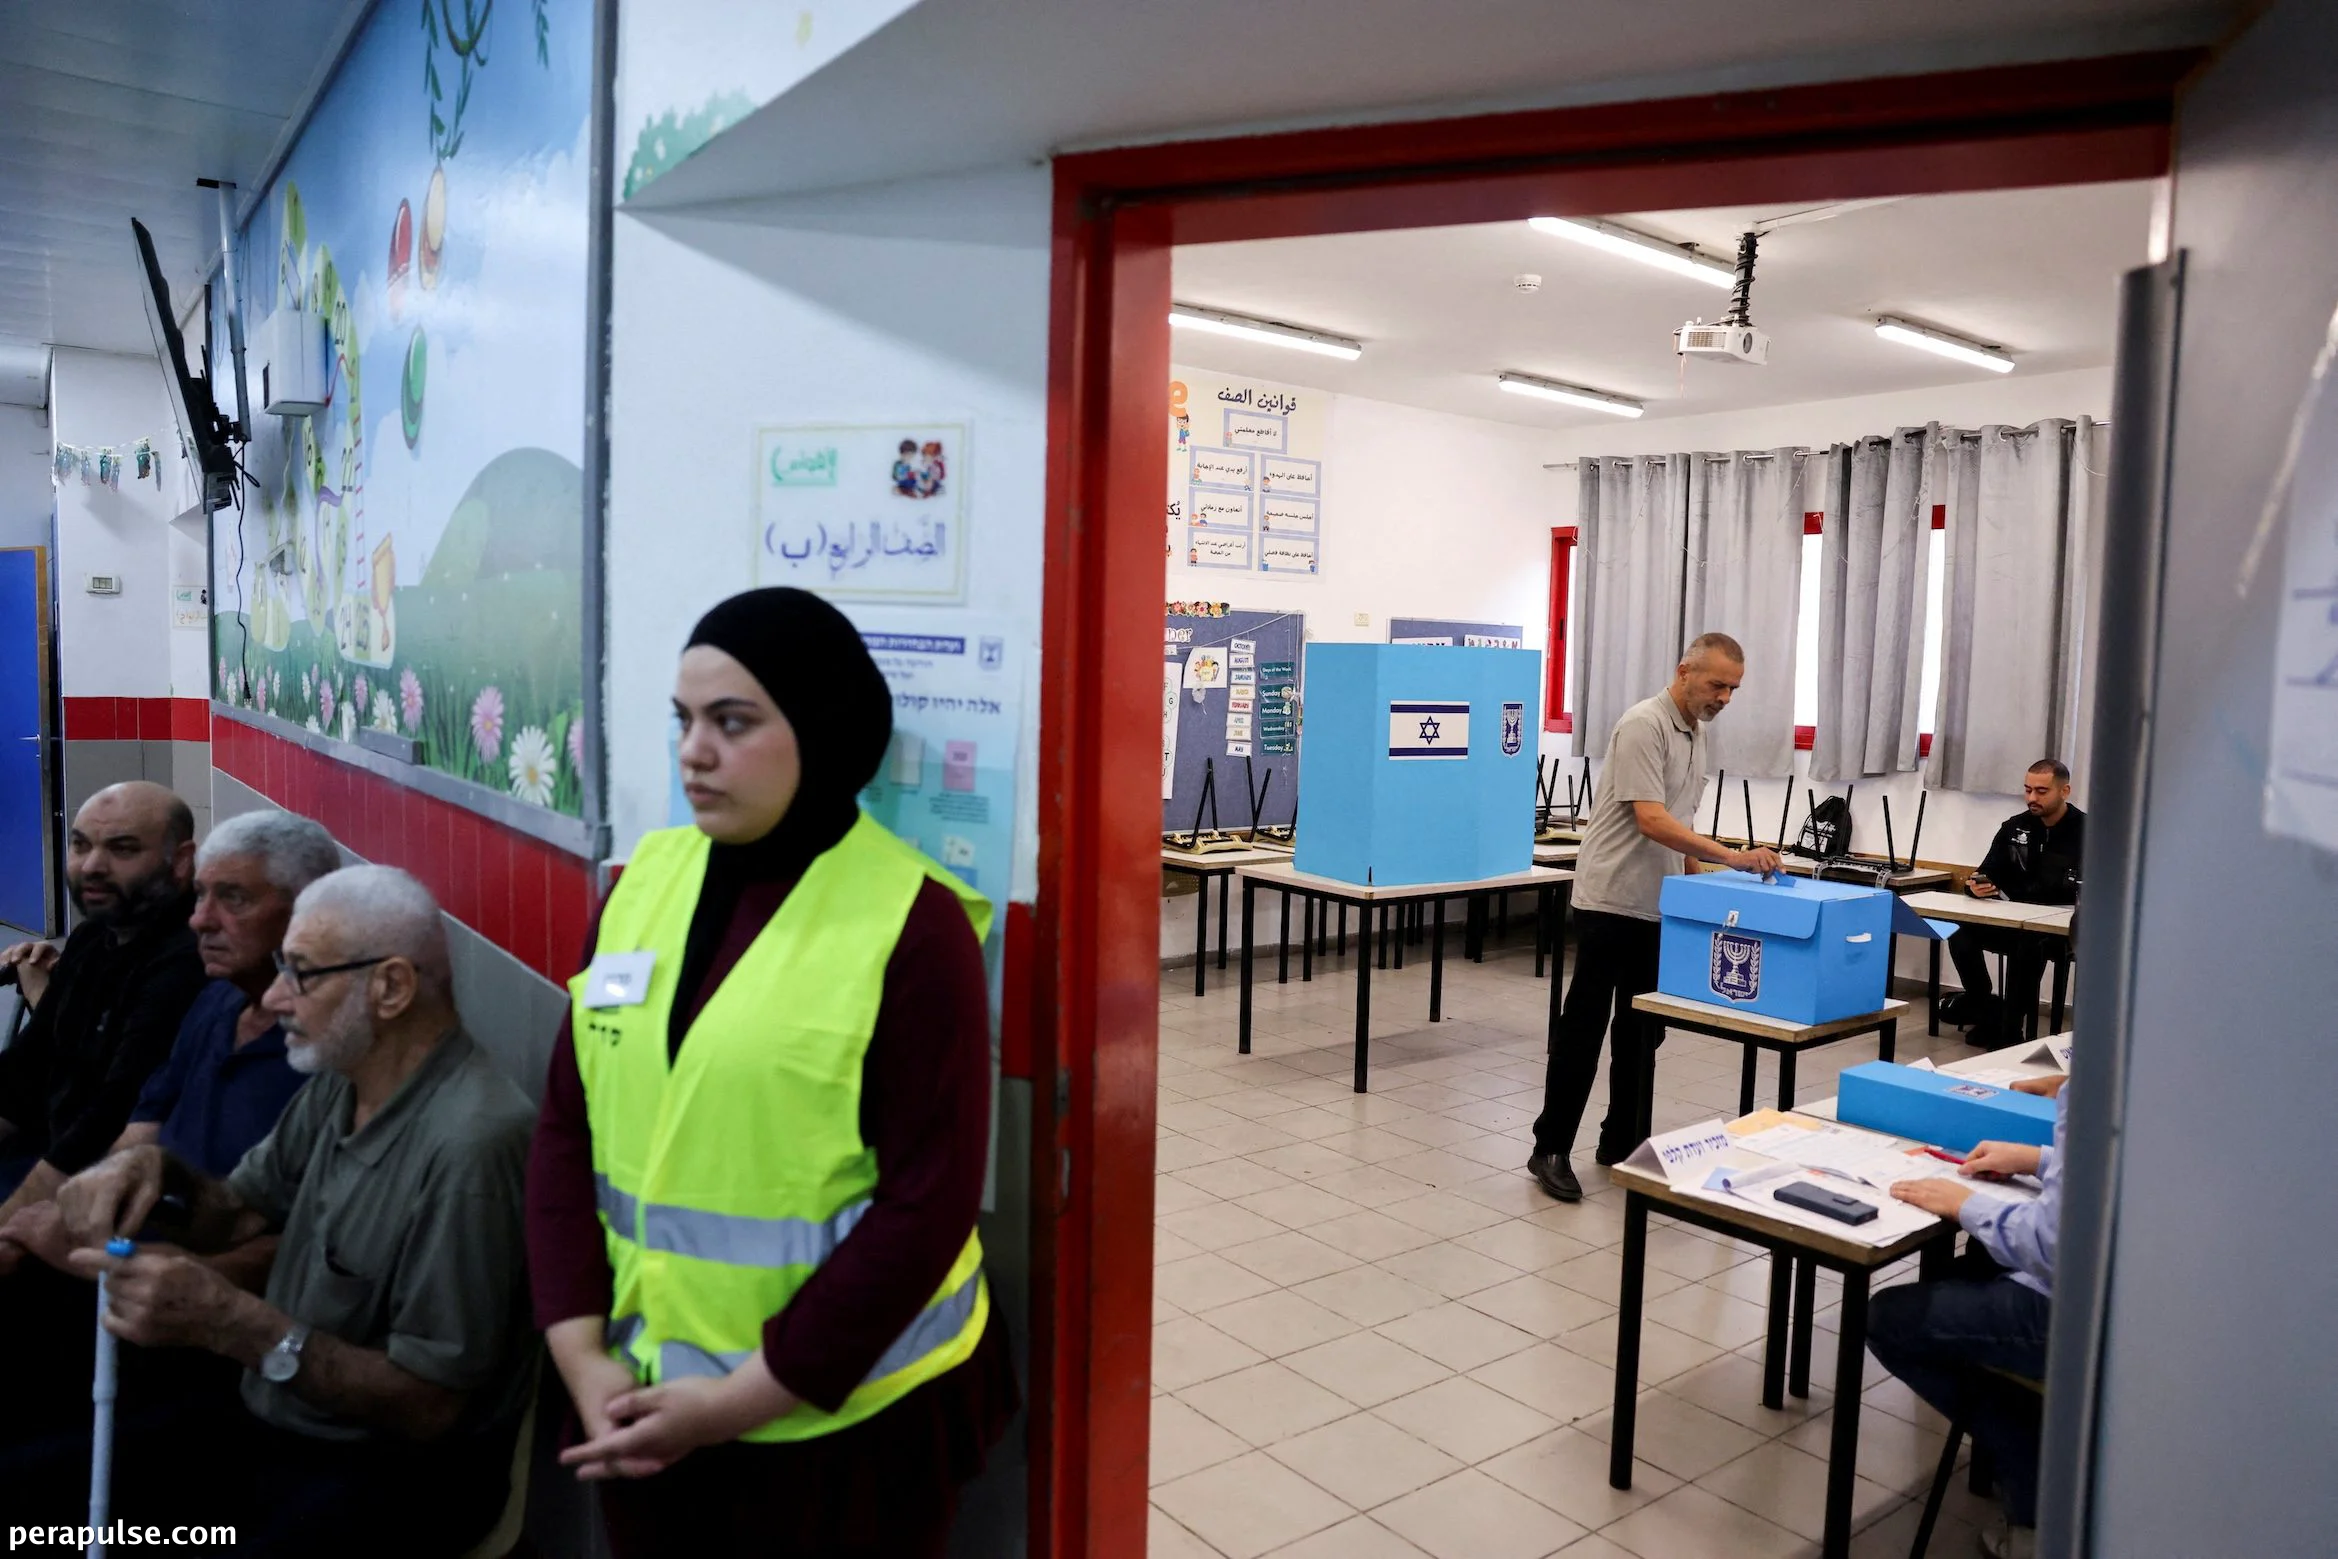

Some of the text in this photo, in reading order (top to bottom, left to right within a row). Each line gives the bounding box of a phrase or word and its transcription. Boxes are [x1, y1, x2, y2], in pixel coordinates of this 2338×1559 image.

[1217, 387, 1297, 415] قوانين الصف
[1262, 690, 1281, 698] Sunday
[1168, 697, 1174, 705] G
[1264, 744, 1284, 753] Tuesday
[1164, 752, 1170, 761] T
[1720, 982, 1749, 998] ישראל
